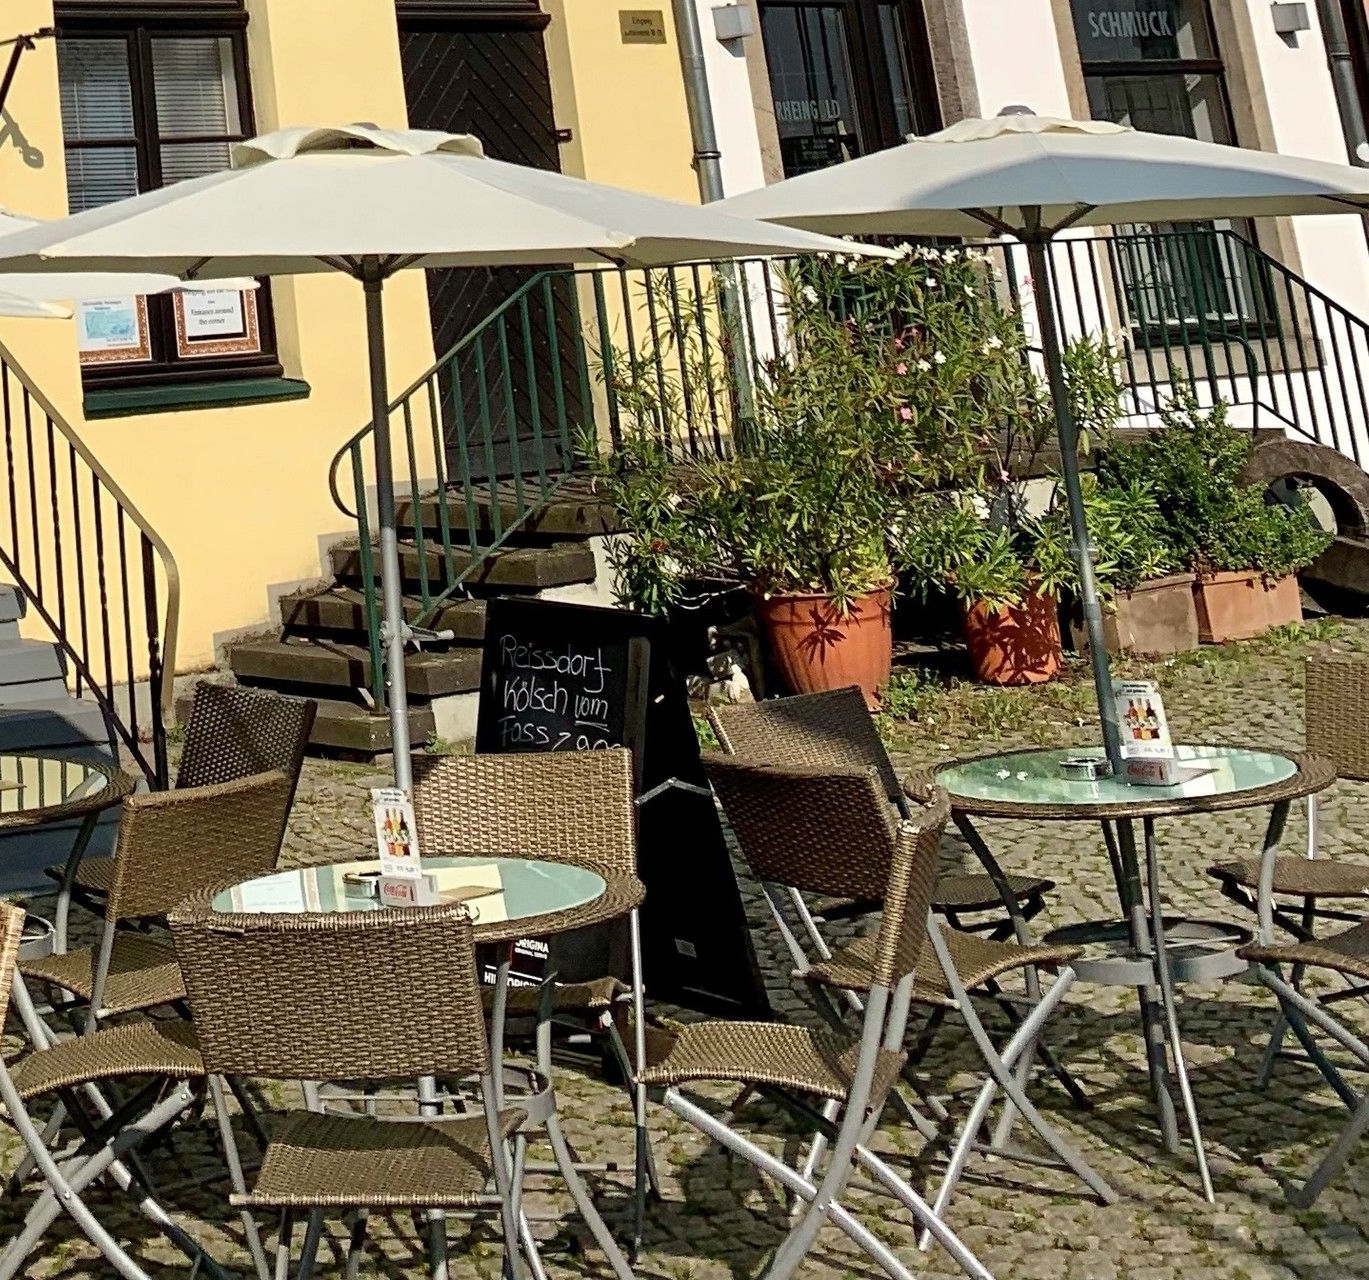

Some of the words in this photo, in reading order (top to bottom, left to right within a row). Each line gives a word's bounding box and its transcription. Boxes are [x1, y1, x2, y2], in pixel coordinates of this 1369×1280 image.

[1087, 10, 1174, 38] SCHMUCK
[775, 99, 841, 121] RHEINGLD
[499, 634, 612, 694] Reissdorf
[503, 676, 569, 716] Kölsch
[574, 694, 609, 720] vom
